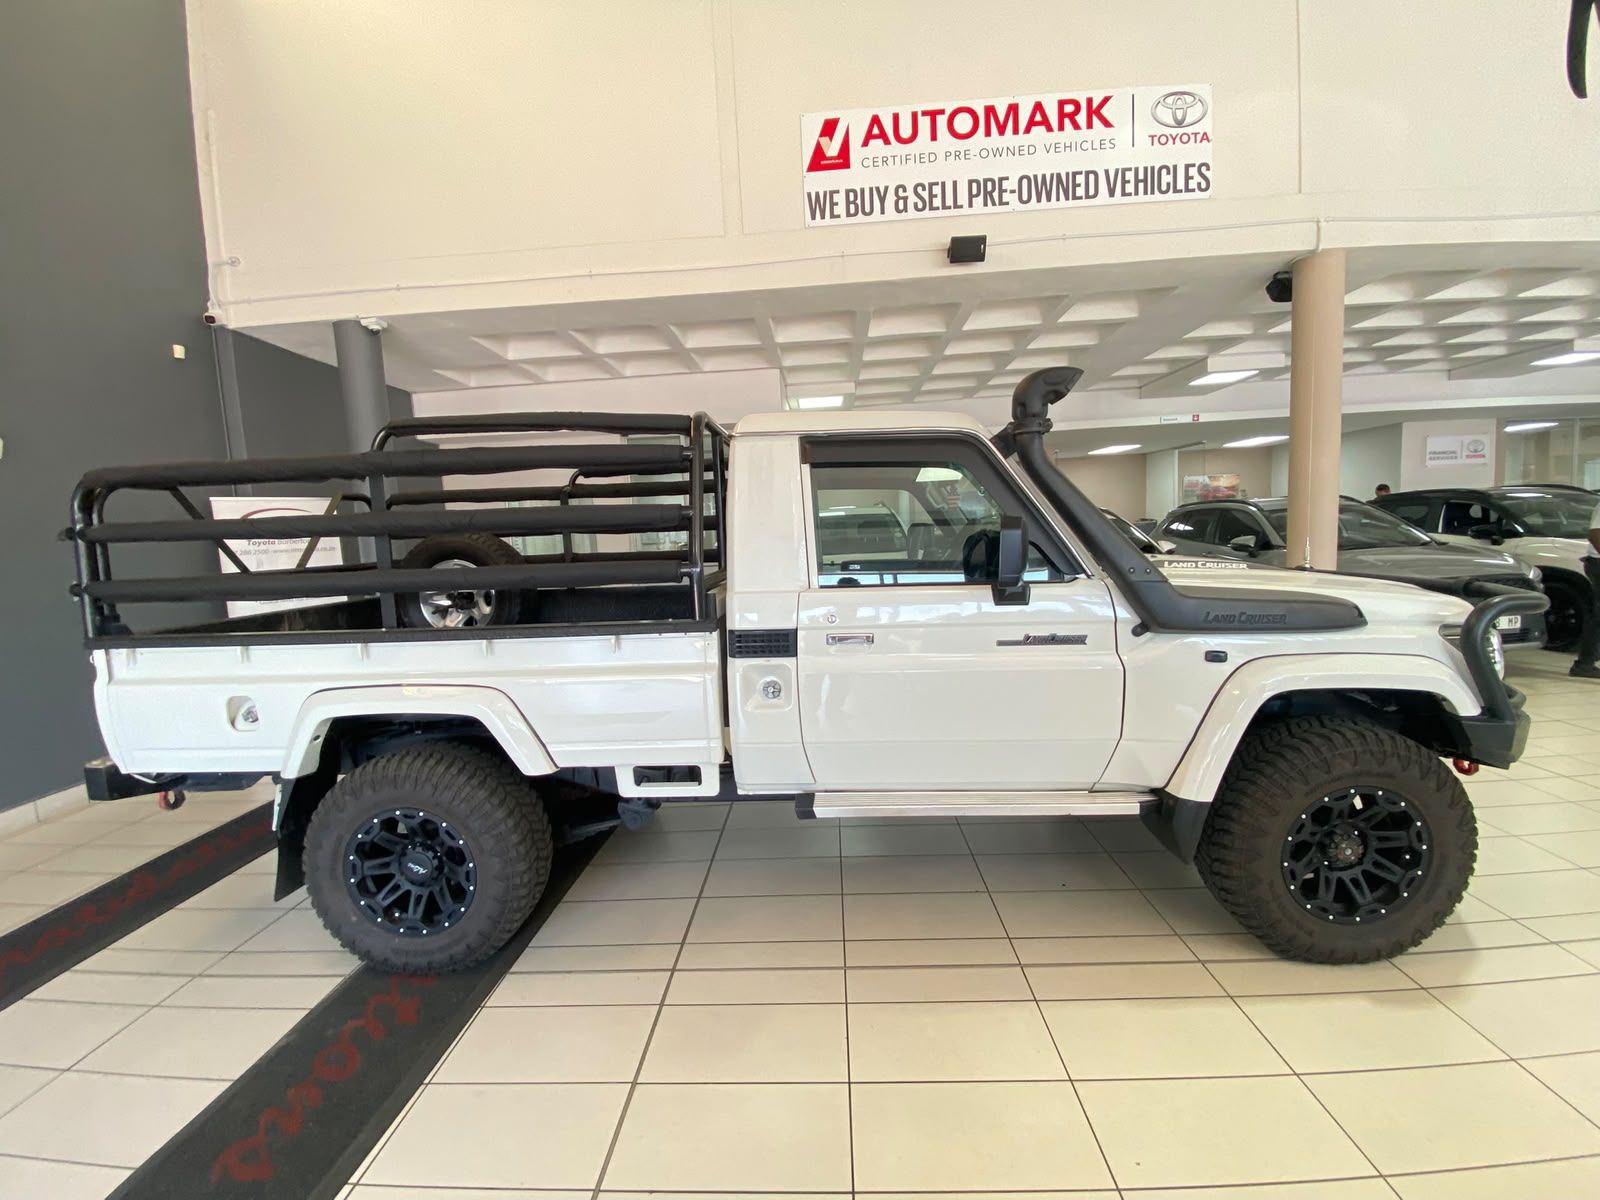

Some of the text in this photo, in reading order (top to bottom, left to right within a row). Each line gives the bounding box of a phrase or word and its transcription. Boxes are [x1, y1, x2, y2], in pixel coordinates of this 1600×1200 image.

[860, 94, 1115, 148] AUTOMARK
[1148, 131, 1211, 147] TOYOTA
[861, 138, 1116, 169] CERTIFIED PRE-OWNED VEHICLES
[806, 161, 1212, 221] WE BUY & SELL PRE-OWNED VEHICLES
[247, 539, 276, 547] Toyota
[1163, 560, 1248, 570] LAND CRUISER
[1203, 611, 1287, 625] LAND CRUISER
